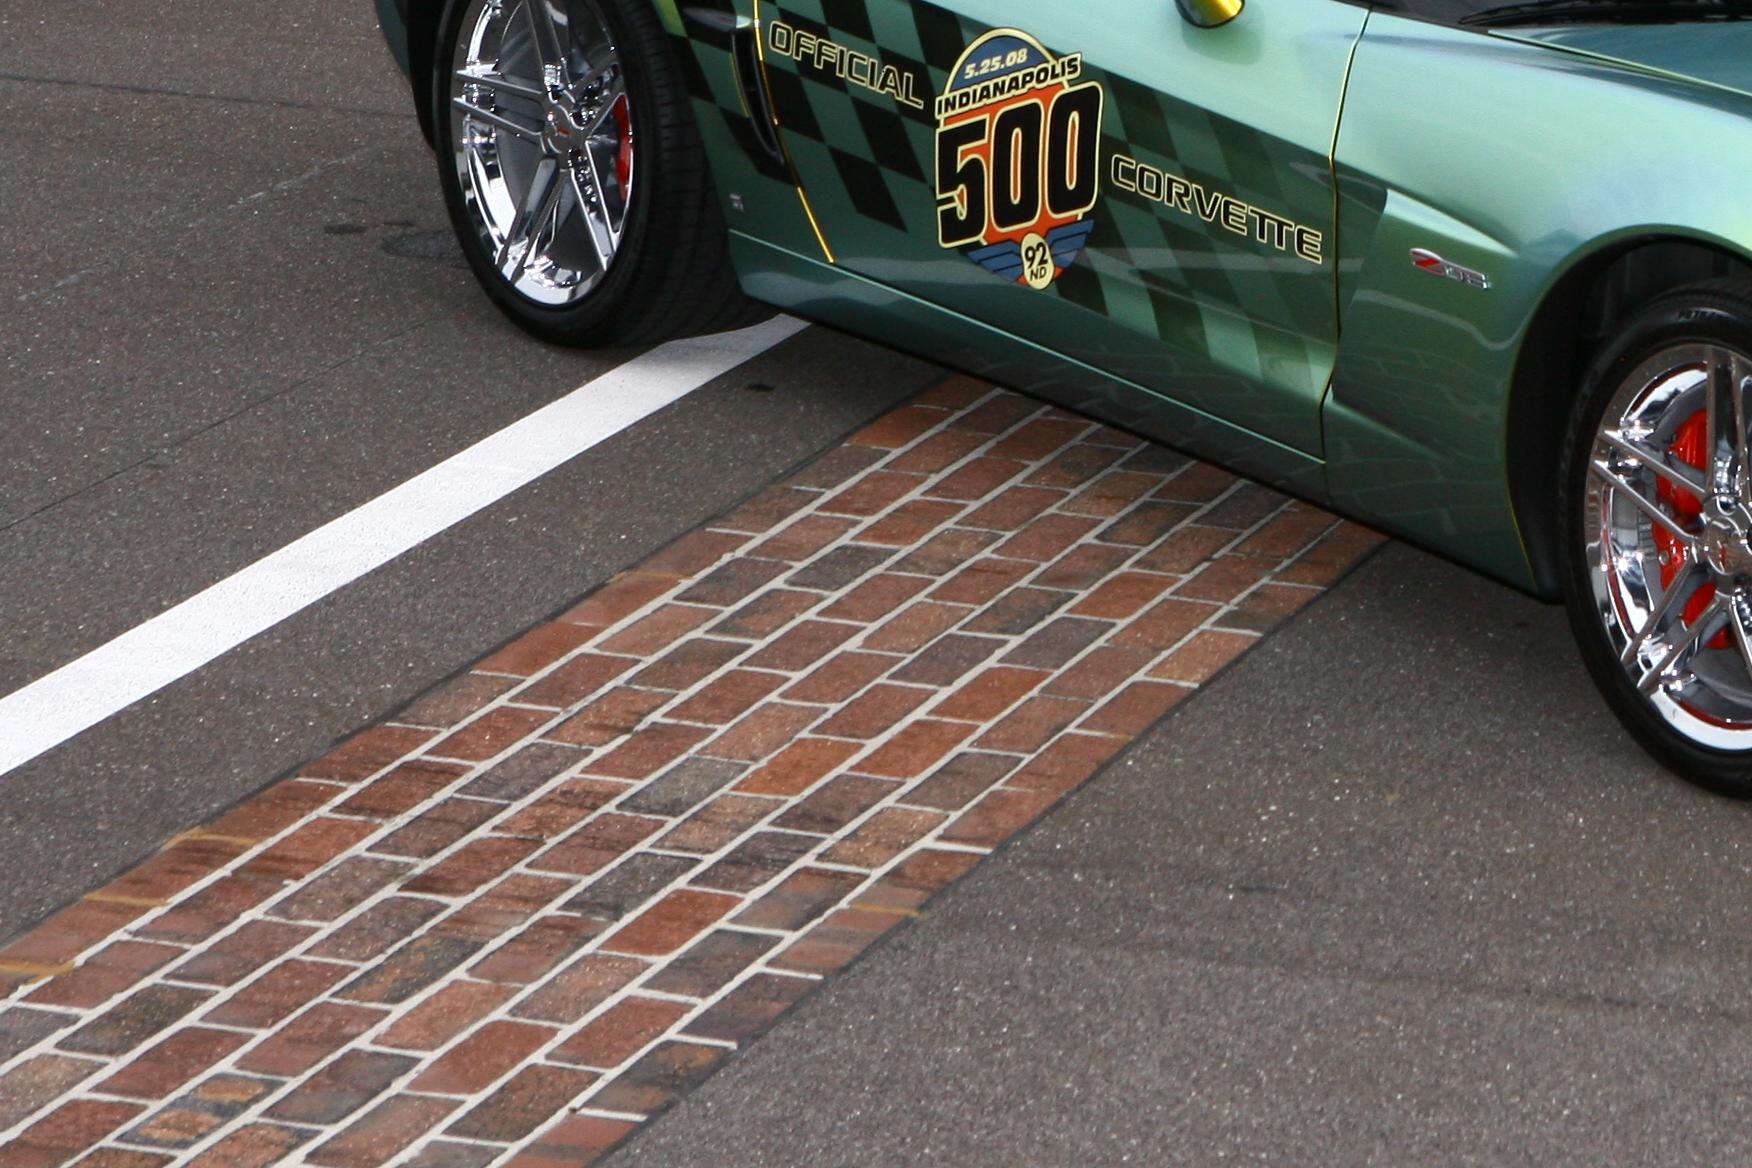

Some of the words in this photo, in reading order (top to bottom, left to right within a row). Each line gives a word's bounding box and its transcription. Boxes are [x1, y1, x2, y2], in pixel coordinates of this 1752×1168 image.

[769, 20, 924, 110] OFFICIAL
[936, 55, 1081, 116] INDIANAPOLIS
[964, 48, 1028, 80] 5.25.08
[936, 81, 1104, 249] 500
[1111, 153, 1322, 265] CORVETTE
[1025, 242, 1048, 269] 92
[1029, 266, 1047, 281] ND
